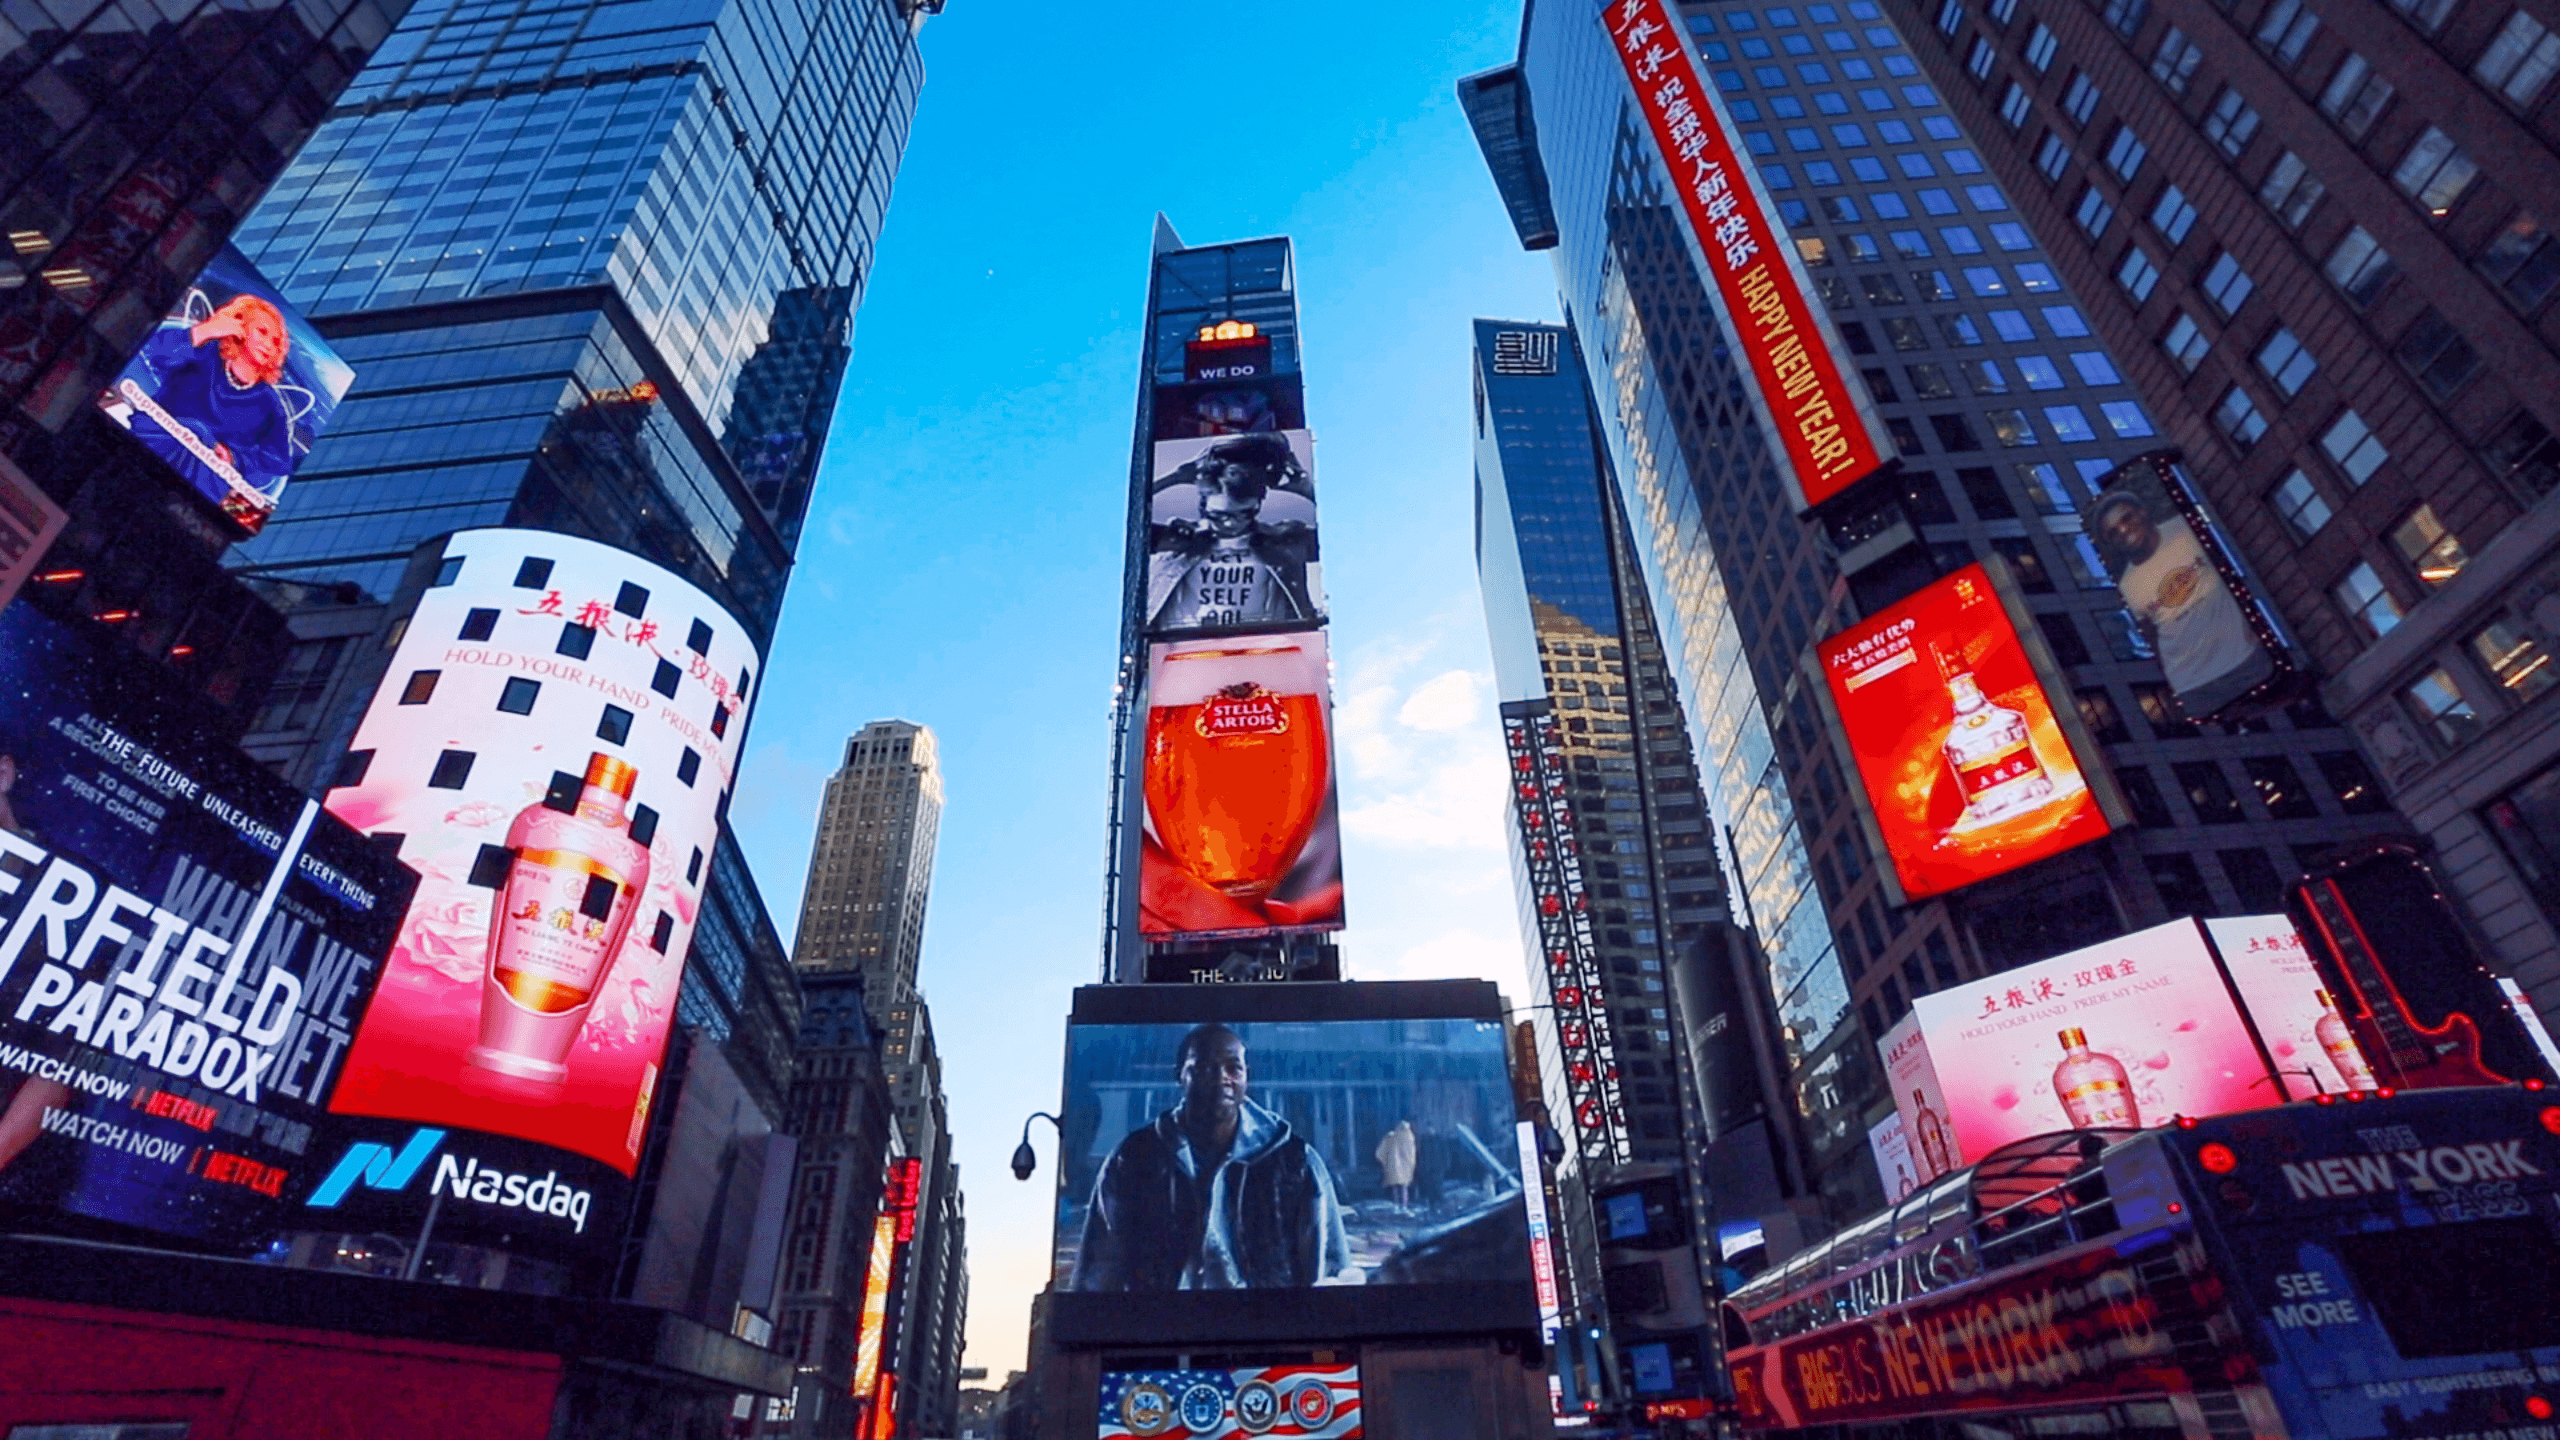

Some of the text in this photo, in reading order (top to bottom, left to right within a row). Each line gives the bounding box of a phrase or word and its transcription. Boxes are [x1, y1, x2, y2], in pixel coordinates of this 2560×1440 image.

[1738, 263, 1794, 342] HAPPY
[1769, 334, 1819, 399] NEW
[1200, 365, 1254, 379] WE DO
[1200, 566, 1254, 585] YOUR
[1200, 588, 1250, 606] SELF
[444, 648, 513, 667] HOLD
[519, 656, 582, 685] YOUR
[588, 675, 650, 710] HAND
[660, 705, 701, 745] PRIDE
[1212, 714, 1275, 729] ARTOIS
[1213, 703, 1273, 717] STELLA
[49, 716, 63, 730] A
[63, 724, 121, 764] SECOND
[62, 774, 158, 835] FIRST CHOICE
[97, 771, 118, 791] TO
[136, 796, 165, 819] HER
[101, 728, 135, 759] THE
[138, 754, 200, 800] FUTURE
[203, 793, 284, 852] UNLEASHED
[299, 853, 336, 884] EVERY
[299, 932, 372, 1030] WE
[14, 963, 273, 1103] PARADOX
[1960, 1024, 1994, 1041] HOLD
[1995, 1014, 2028, 1032] YOUR
[2030, 1003, 2067, 1022] HAND
[0, 1040, 219, 1134] WATCH NOW NETFLIX
[39, 1105, 290, 1198] WATCH NOW NETFLIX
[2283, 1138, 2546, 1200] NEW YORK
[430, 1153, 592, 1234] Nasdaq
[2275, 1271, 2331, 1299] SEE
[2271, 1299, 2360, 1329] MORE
